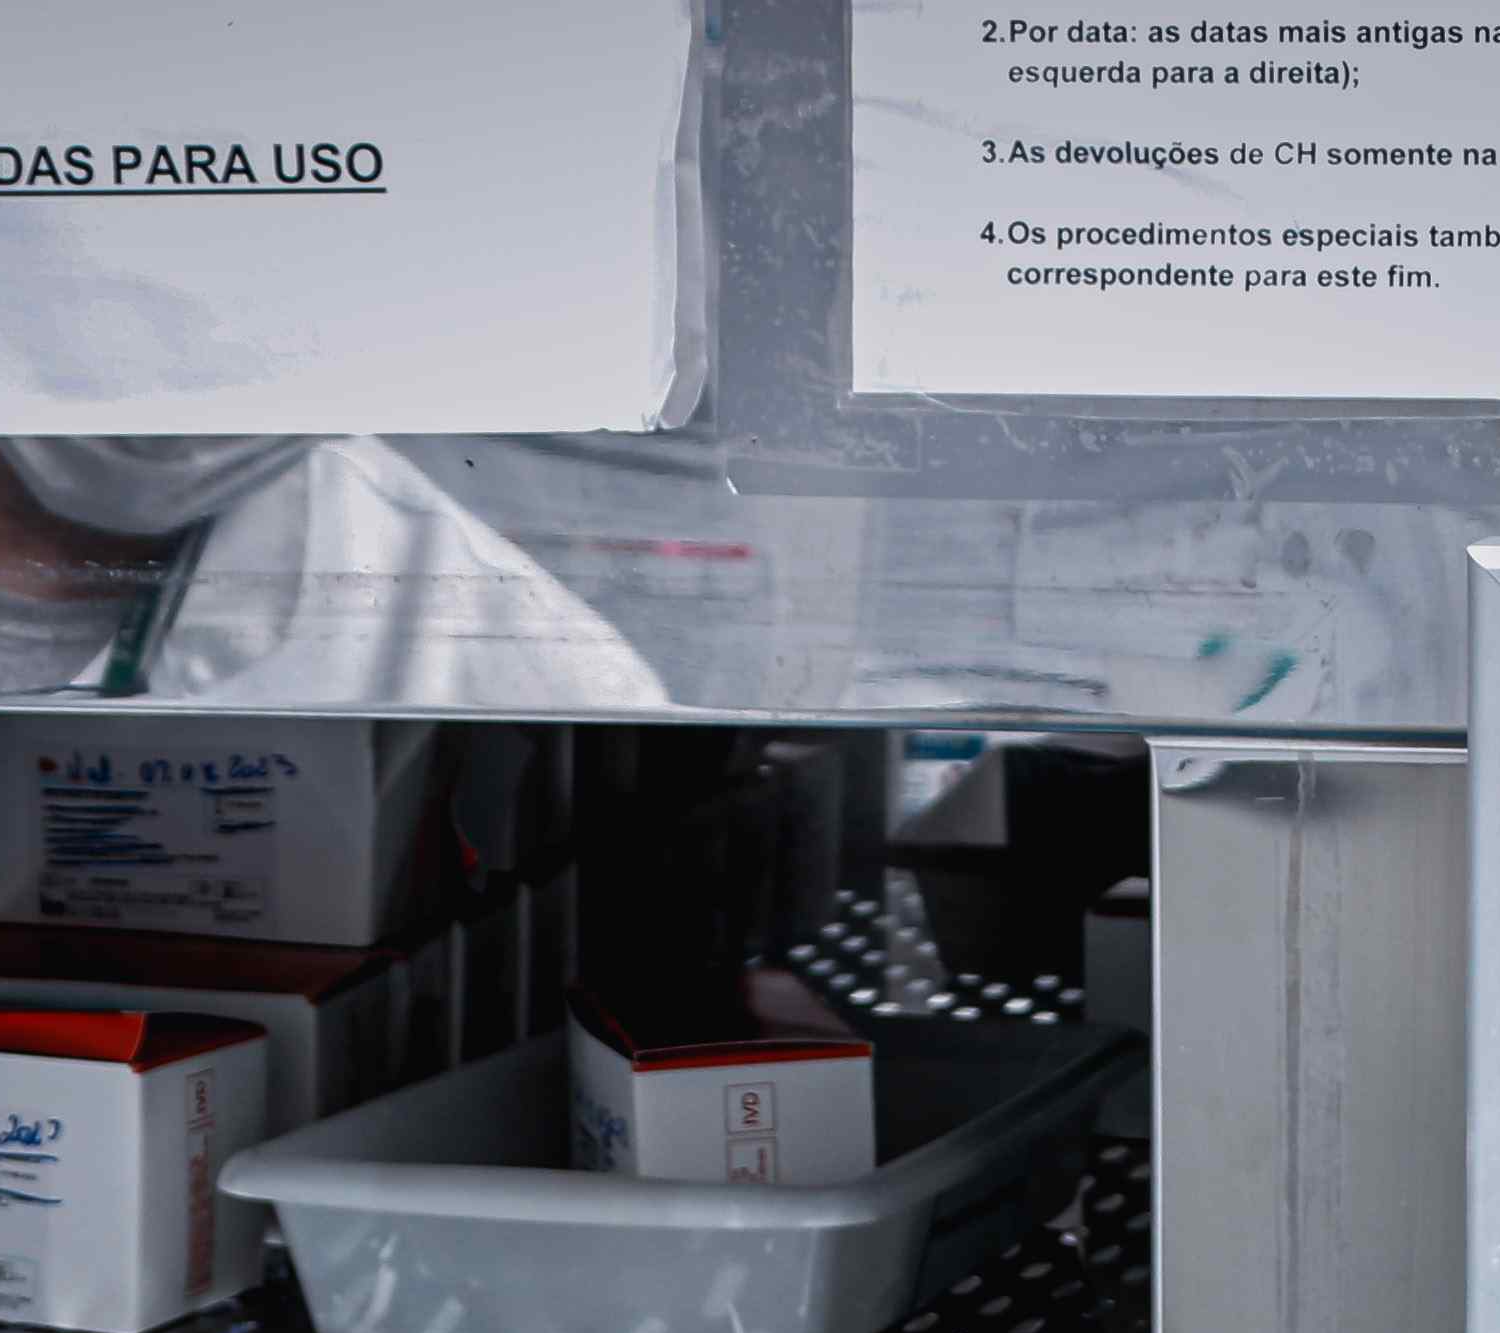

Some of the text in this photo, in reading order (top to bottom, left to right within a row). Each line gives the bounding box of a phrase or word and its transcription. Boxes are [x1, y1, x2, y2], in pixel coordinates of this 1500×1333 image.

[1067, 19, 1137, 43] data:
[1148, 25, 1180, 43] as
[1190, 20, 1268, 44] datas
[1279, 19, 1346, 44] mais
[1356, 20, 1464, 50] antigas
[1008, 60, 1359, 90] esquerda para a direita);
[113, 144, 257, 187] PARA
[273, 142, 383, 185] USO
[1055, 140, 1219, 170] devoluções
[1230, 142, 1264, 165] de
[1275, 141, 1316, 165] CH
[1327, 143, 1453, 166] somente
[1463, 148, 1497, 166] na
[1057, 222, 1272, 250] procedimentos
[1282, 223, 1419, 252] especiais
[1007, 263, 1439, 292] correspondente para este fim.
